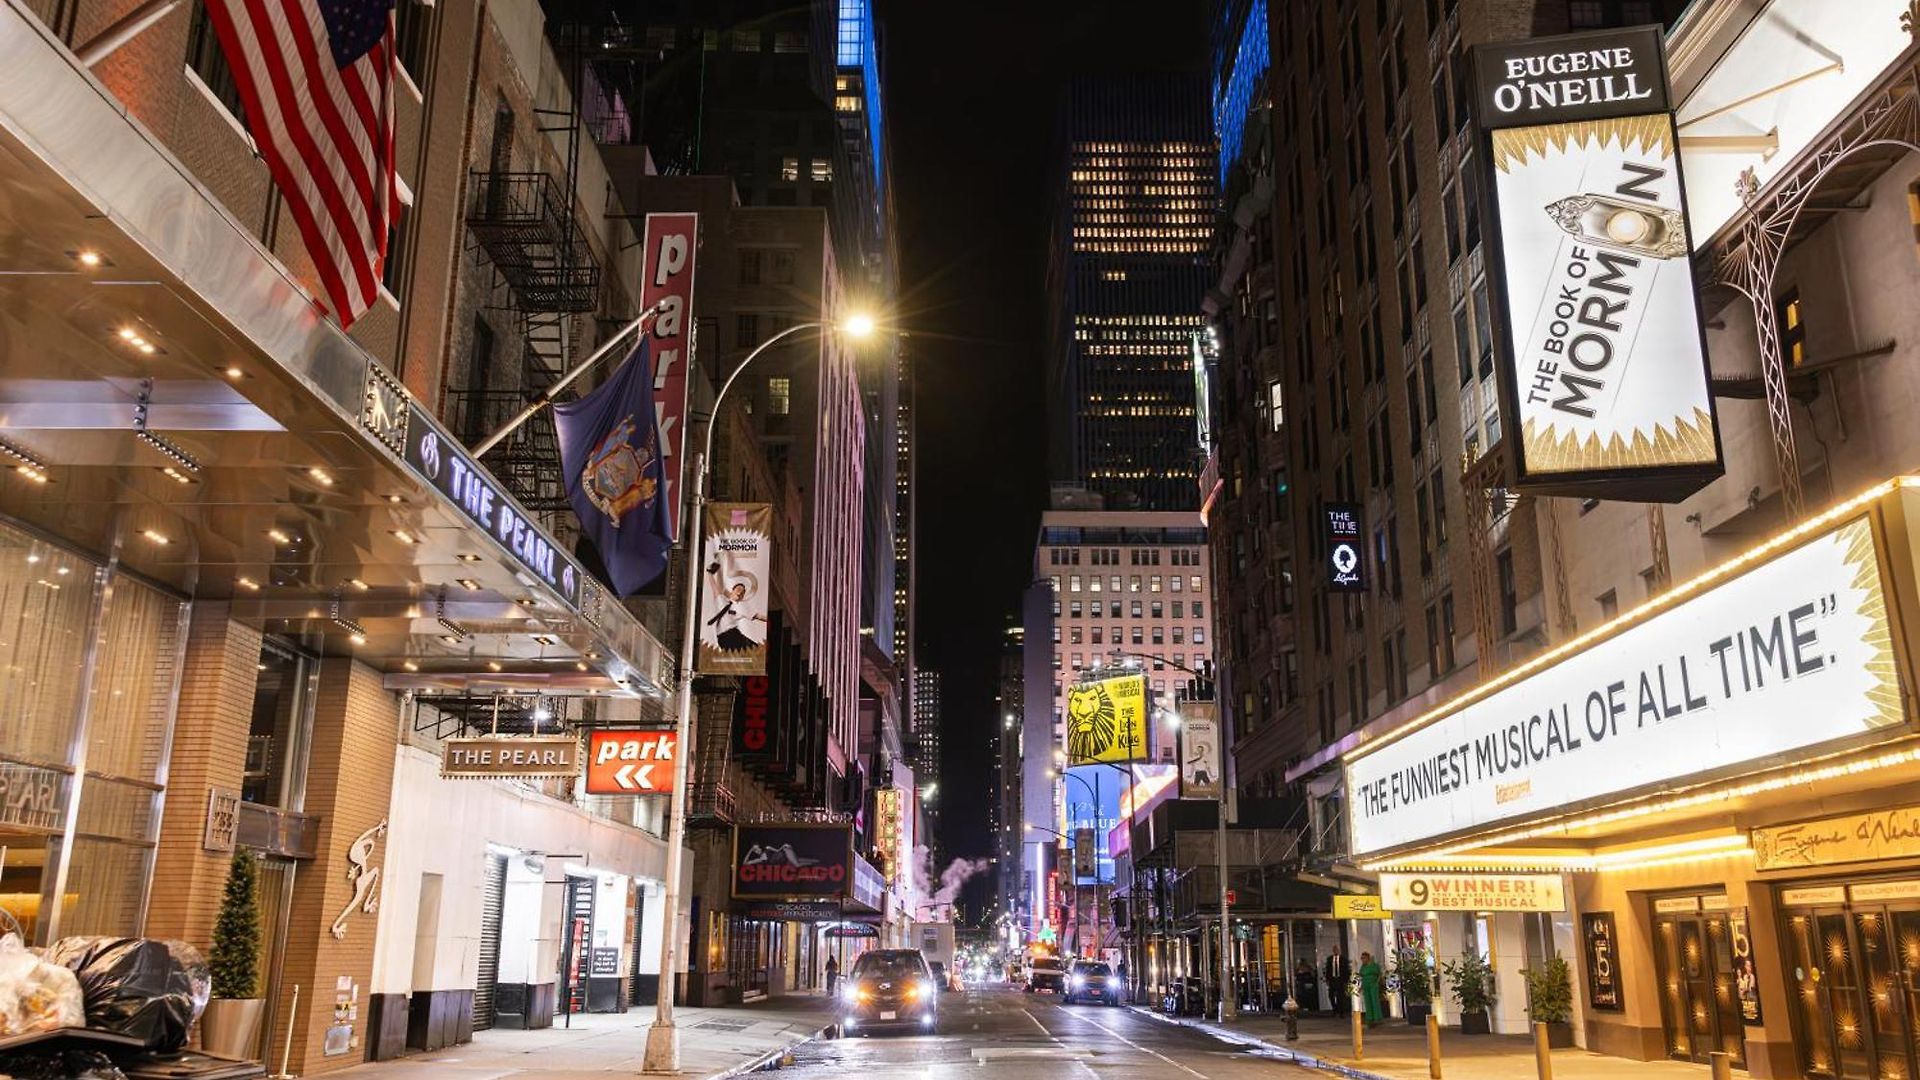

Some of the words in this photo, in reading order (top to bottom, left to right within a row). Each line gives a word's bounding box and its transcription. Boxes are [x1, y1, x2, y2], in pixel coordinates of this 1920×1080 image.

[1505, 47, 1634, 79] EUGENE
[1494, 73, 1652, 113] O'NEILL
[1527, 358, 1558, 405] THE
[1544, 284, 1582, 356] BOOK
[1567, 245, 1590, 279] OF
[653, 233, 688, 457] park
[451, 455, 495, 529] THE
[500, 504, 557, 585] PEARL
[1328, 511, 1350, 520] THE
[743, 676, 769, 749] CHIC
[1121, 706, 1135, 716] THE
[1391, 743, 1470, 810] FUNNIEST
[1476, 709, 1582, 781] MUSICAL
[1585, 680, 1625, 742] OF
[1636, 655, 1706, 728] ALL
[451, 748, 491, 765] THE
[498, 748, 570, 766] PEARL
[597, 734, 676, 765] park
[740, 863, 846, 882] CHICAGO
[1409, 879, 1429, 906] 9
[1431, 879, 1536, 893] WINNER!
[1432, 898, 1467, 907] BEST
[1474, 897, 1537, 907] MUSICAL
